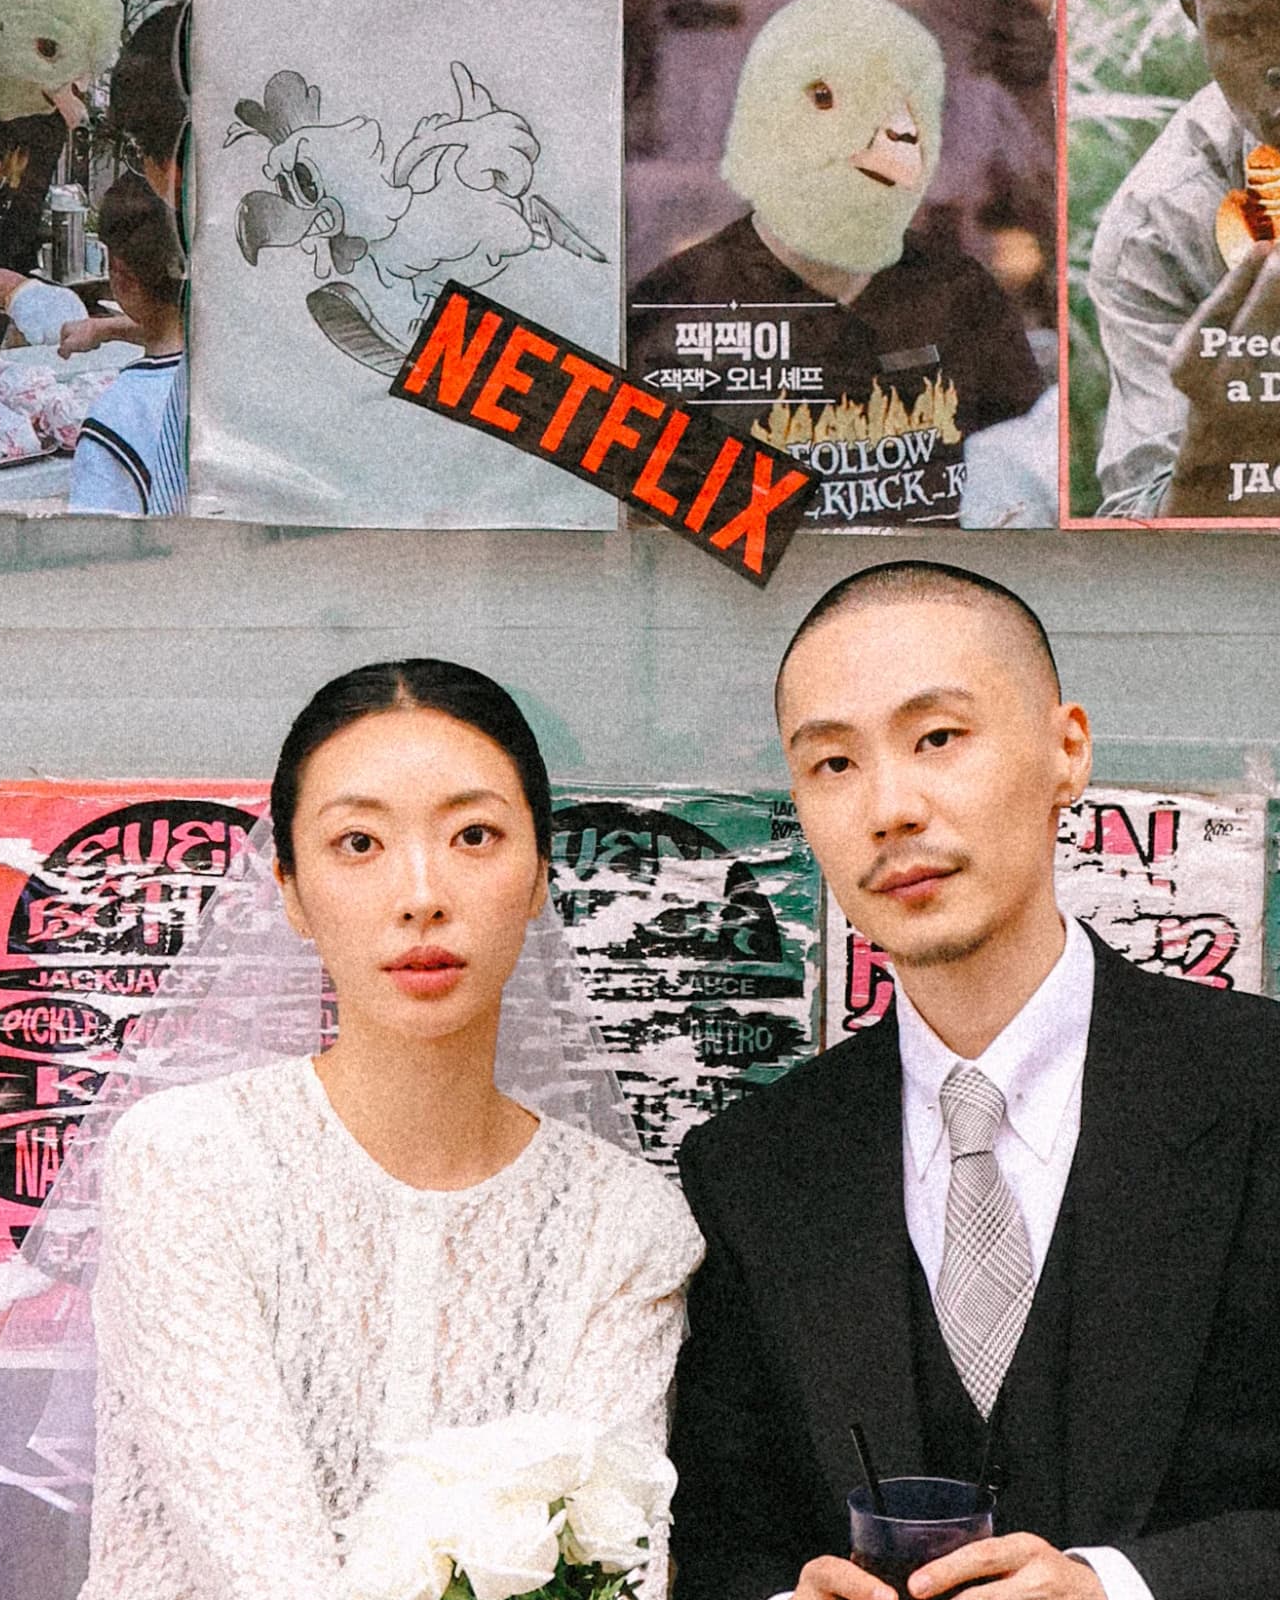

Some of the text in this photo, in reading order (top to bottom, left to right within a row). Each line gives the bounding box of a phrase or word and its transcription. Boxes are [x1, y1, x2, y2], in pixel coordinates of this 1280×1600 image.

[726, 368, 771, 391] 오너
[1227, 380, 1251, 401] a
[405, 293, 808, 574] NETFLIX
